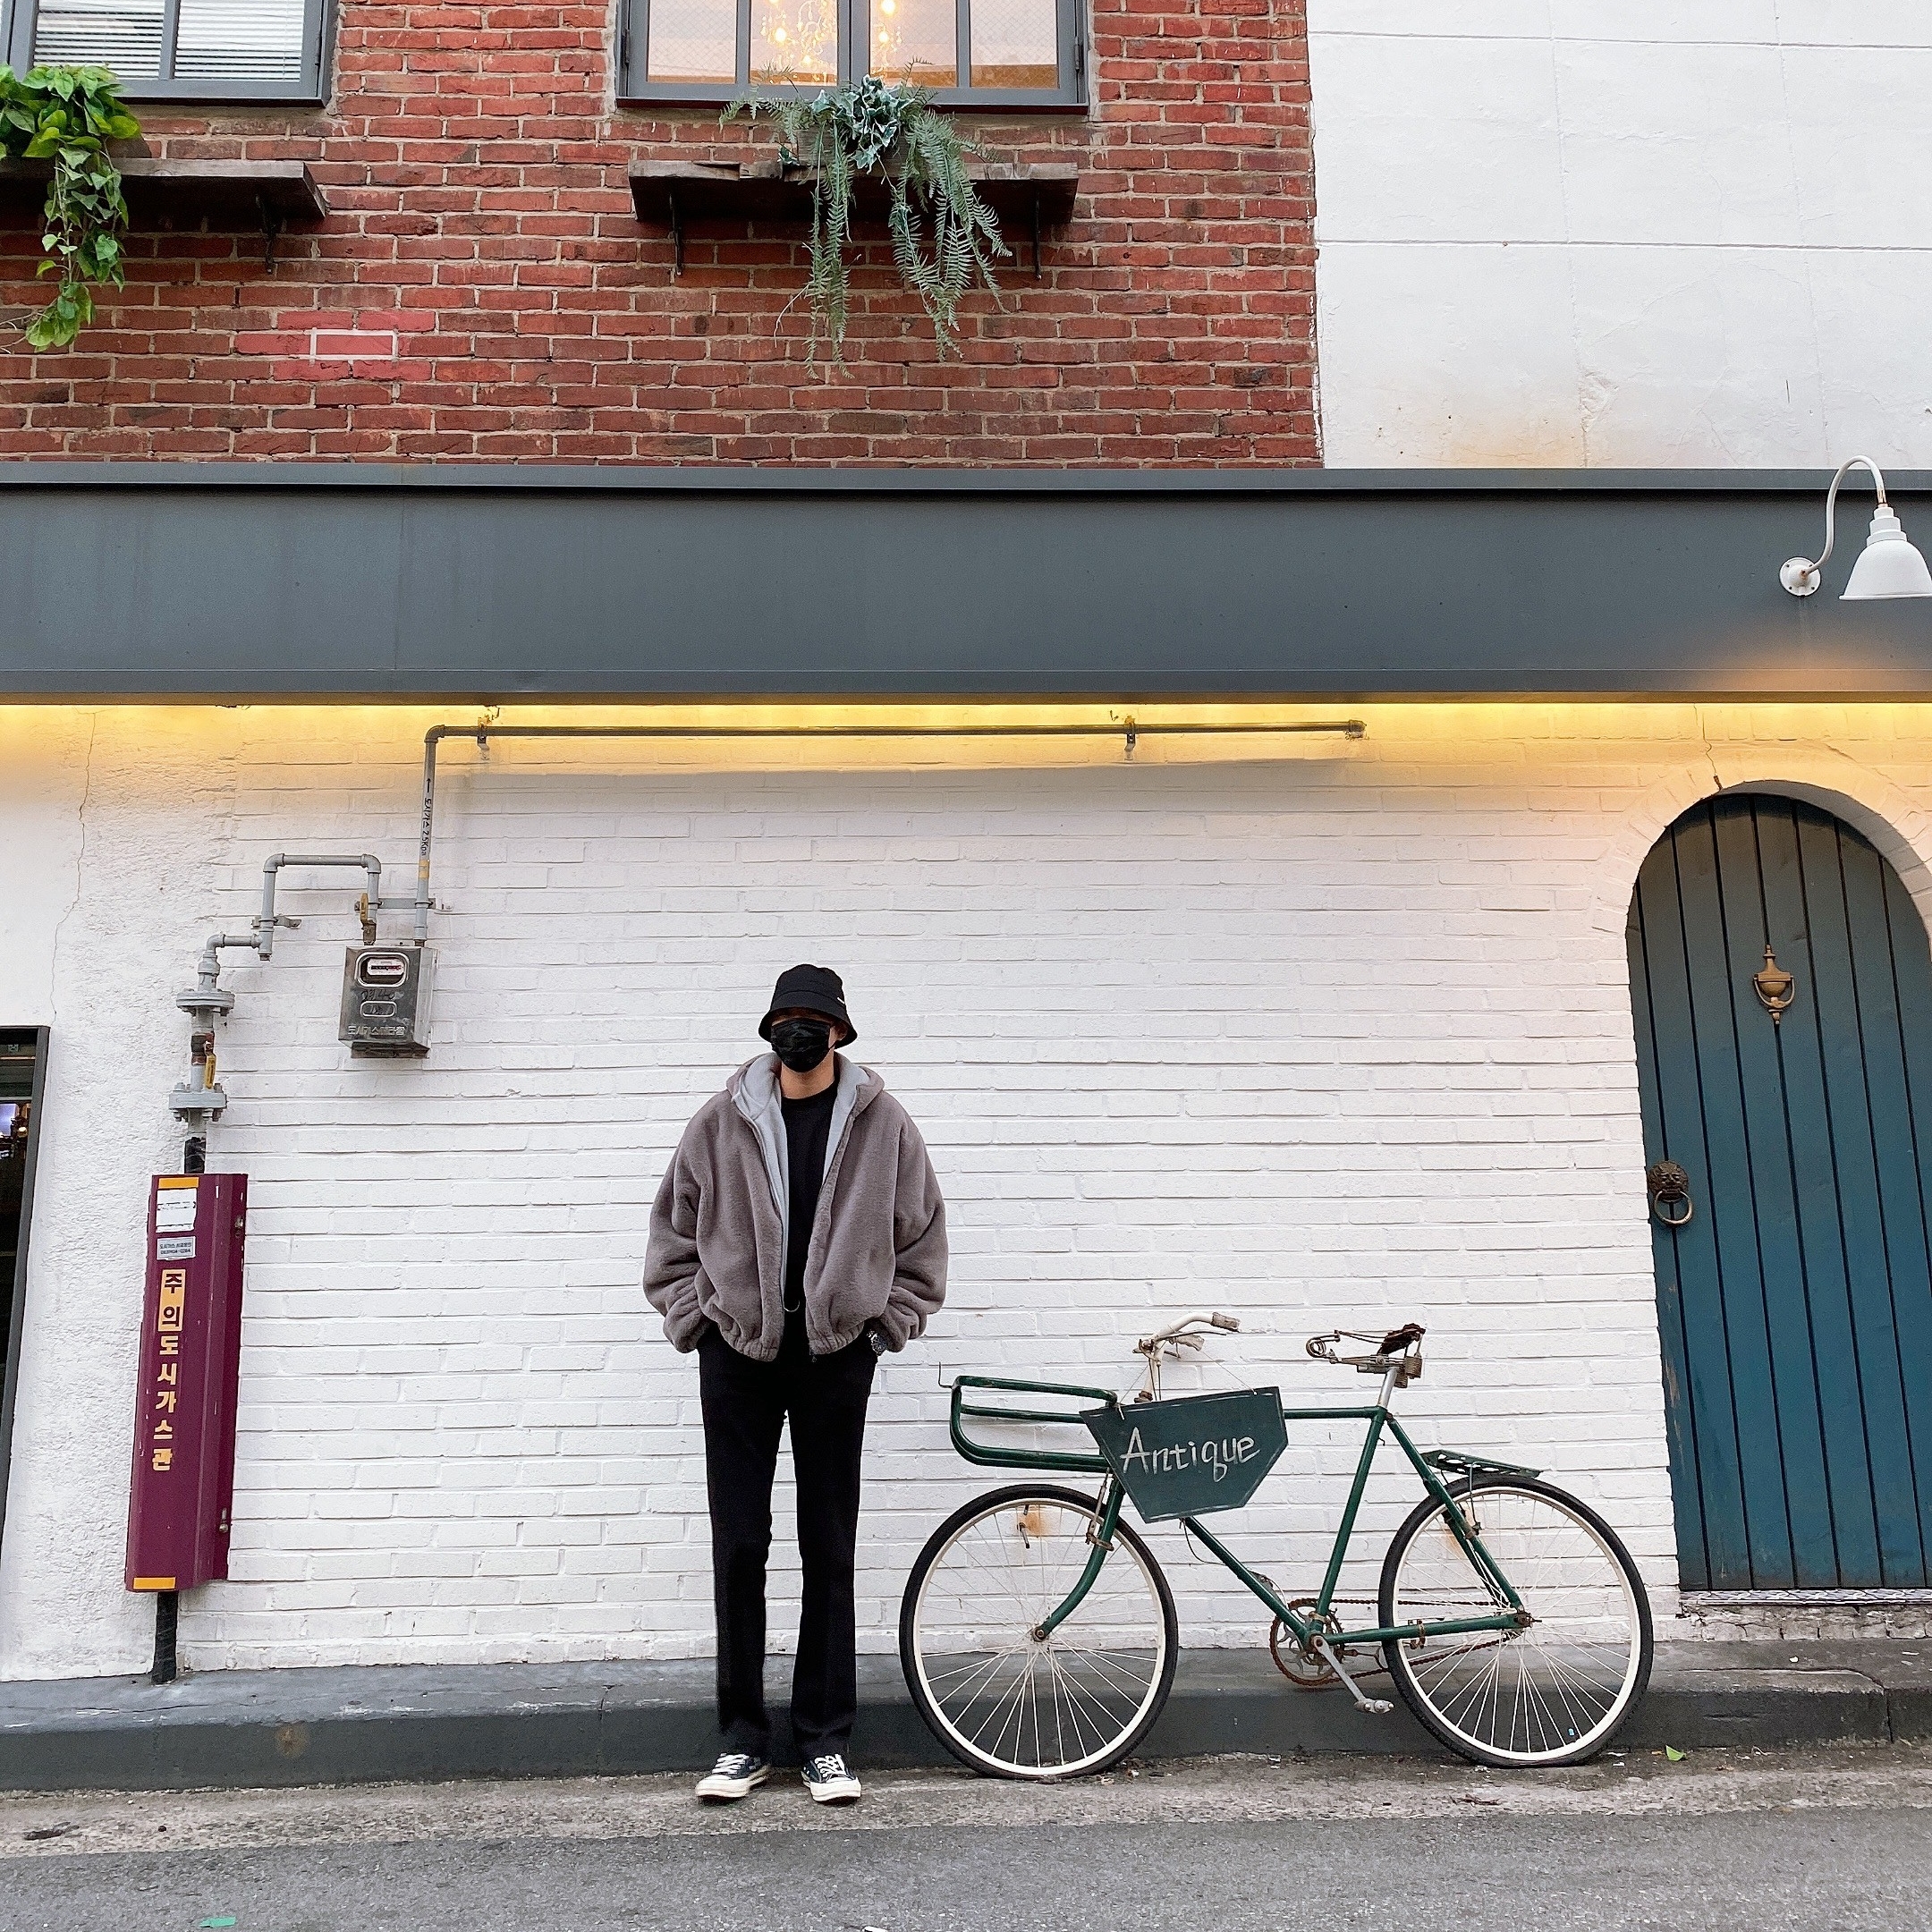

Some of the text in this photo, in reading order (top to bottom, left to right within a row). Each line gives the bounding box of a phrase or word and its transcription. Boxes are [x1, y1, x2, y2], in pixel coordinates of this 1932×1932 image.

[423, 797, 432, 829] 도시가스
[162, 1273, 182, 1328] 주의
[152, 1335, 179, 1471] 도시가스관
[1119, 1426, 1261, 1483] Antique
